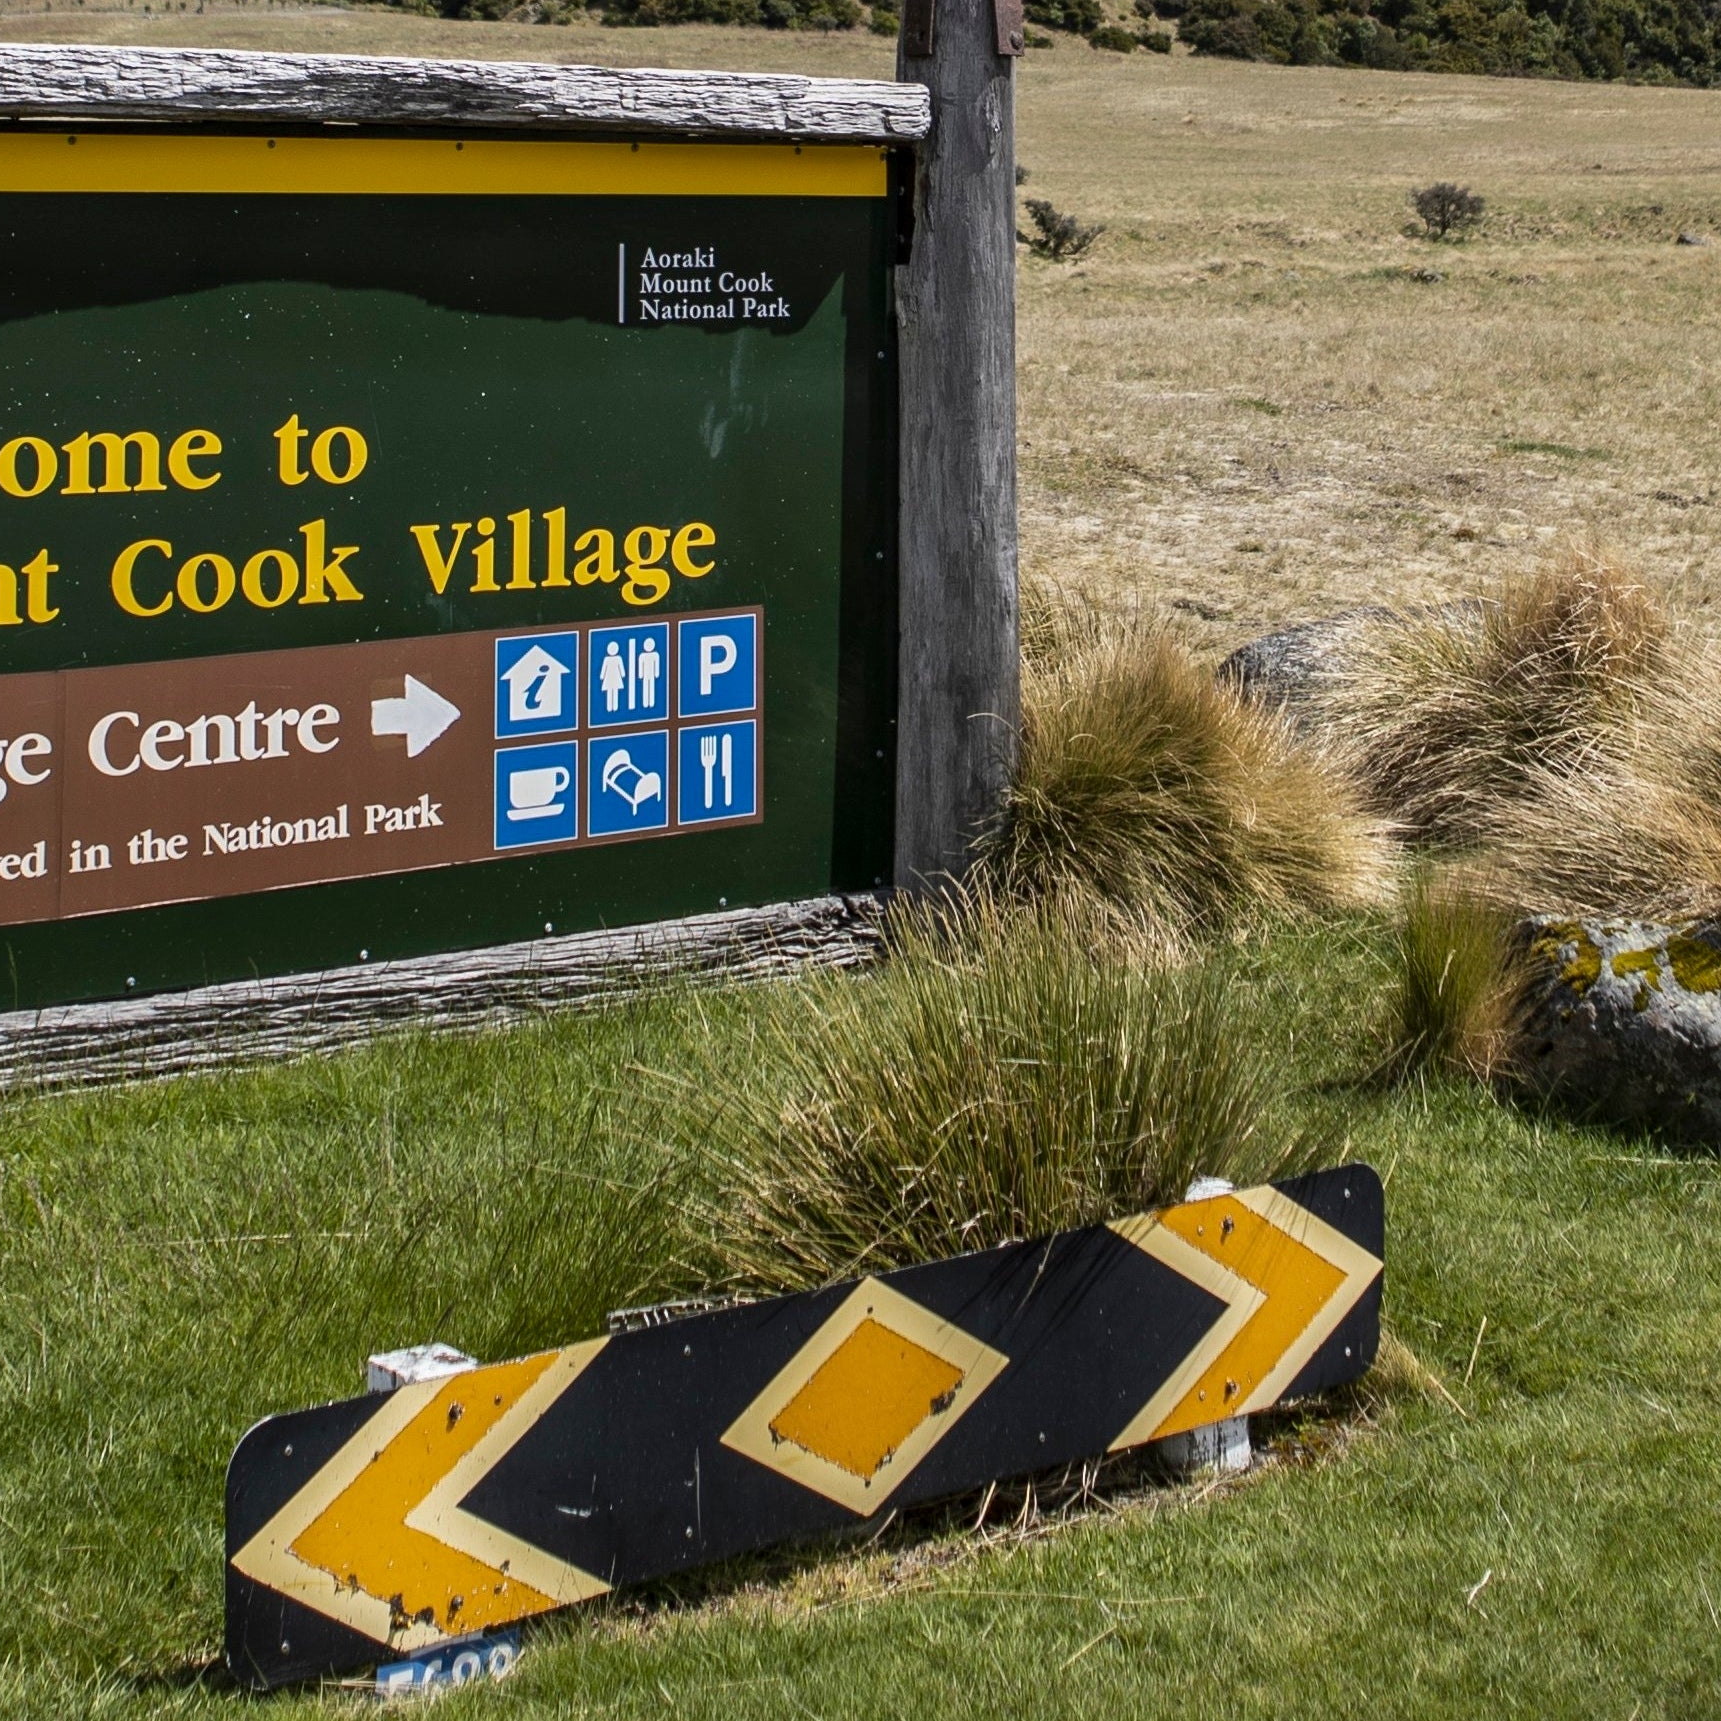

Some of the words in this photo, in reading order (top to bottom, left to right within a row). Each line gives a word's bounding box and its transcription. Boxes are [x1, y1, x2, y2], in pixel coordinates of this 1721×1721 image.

[640, 273, 711, 293] Mount
[719, 272, 773, 292] Cook
[641, 247, 714, 268] Aoraki
[640, 298, 734, 319] National
[743, 297, 790, 317] Park
[274, 414, 367, 485] to
[112, 519, 363, 616] Cook
[410, 507, 715, 605] Village
[701, 636, 736, 694] P
[89, 701, 339, 775] Centre
[70, 841, 111, 872] in
[128, 829, 187, 864] the
[203, 805, 349, 855] National
[365, 794, 443, 834] Park
